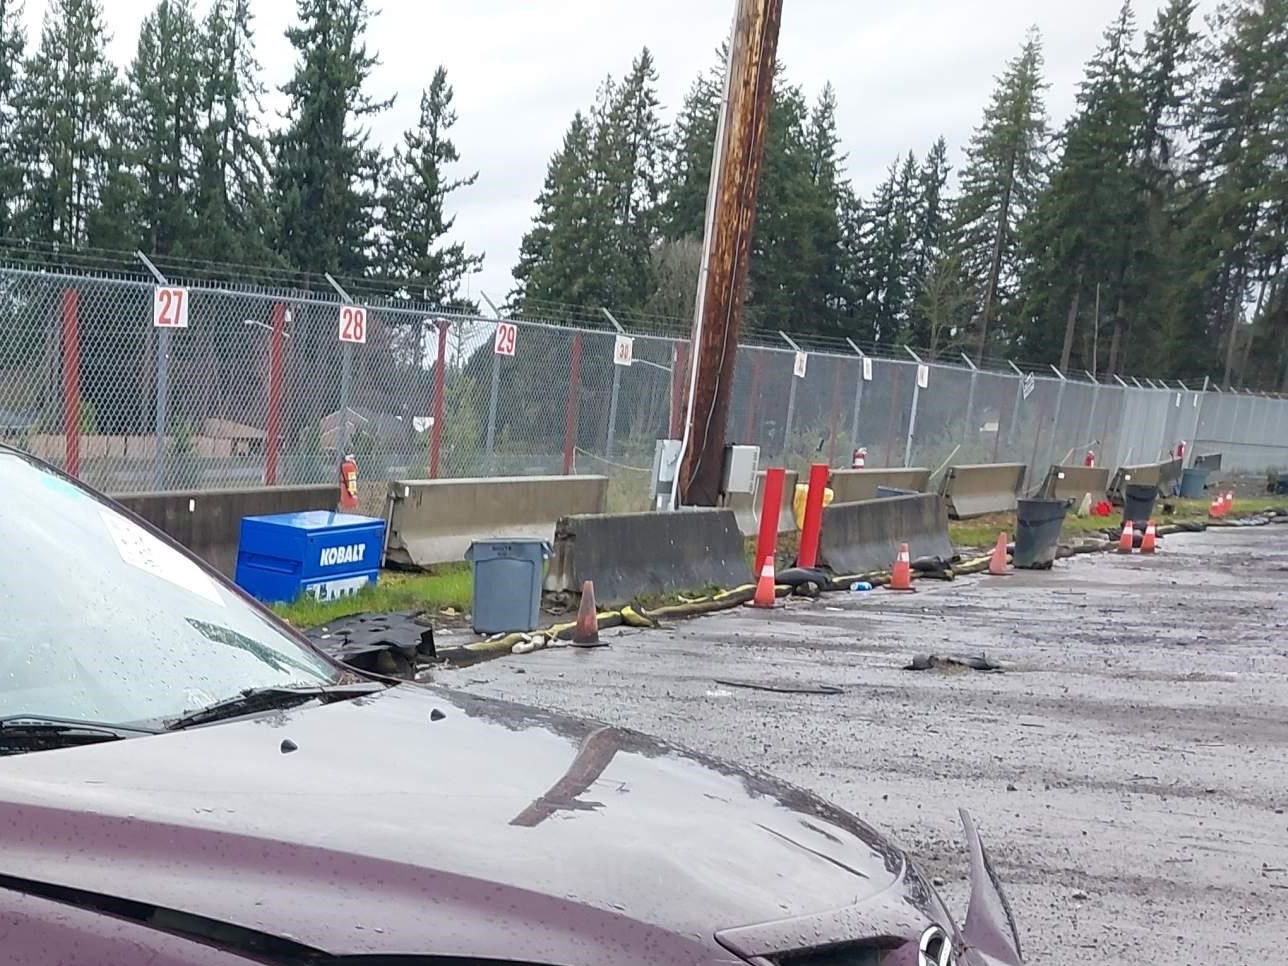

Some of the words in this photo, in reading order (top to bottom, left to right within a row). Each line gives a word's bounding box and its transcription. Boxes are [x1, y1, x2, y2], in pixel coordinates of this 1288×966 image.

[158, 290, 184, 325] 27
[342, 308, 363, 340] 28
[497, 325, 516, 353] 29
[619, 343, 629, 359] 30
[320, 543, 366, 567] KOBALT
